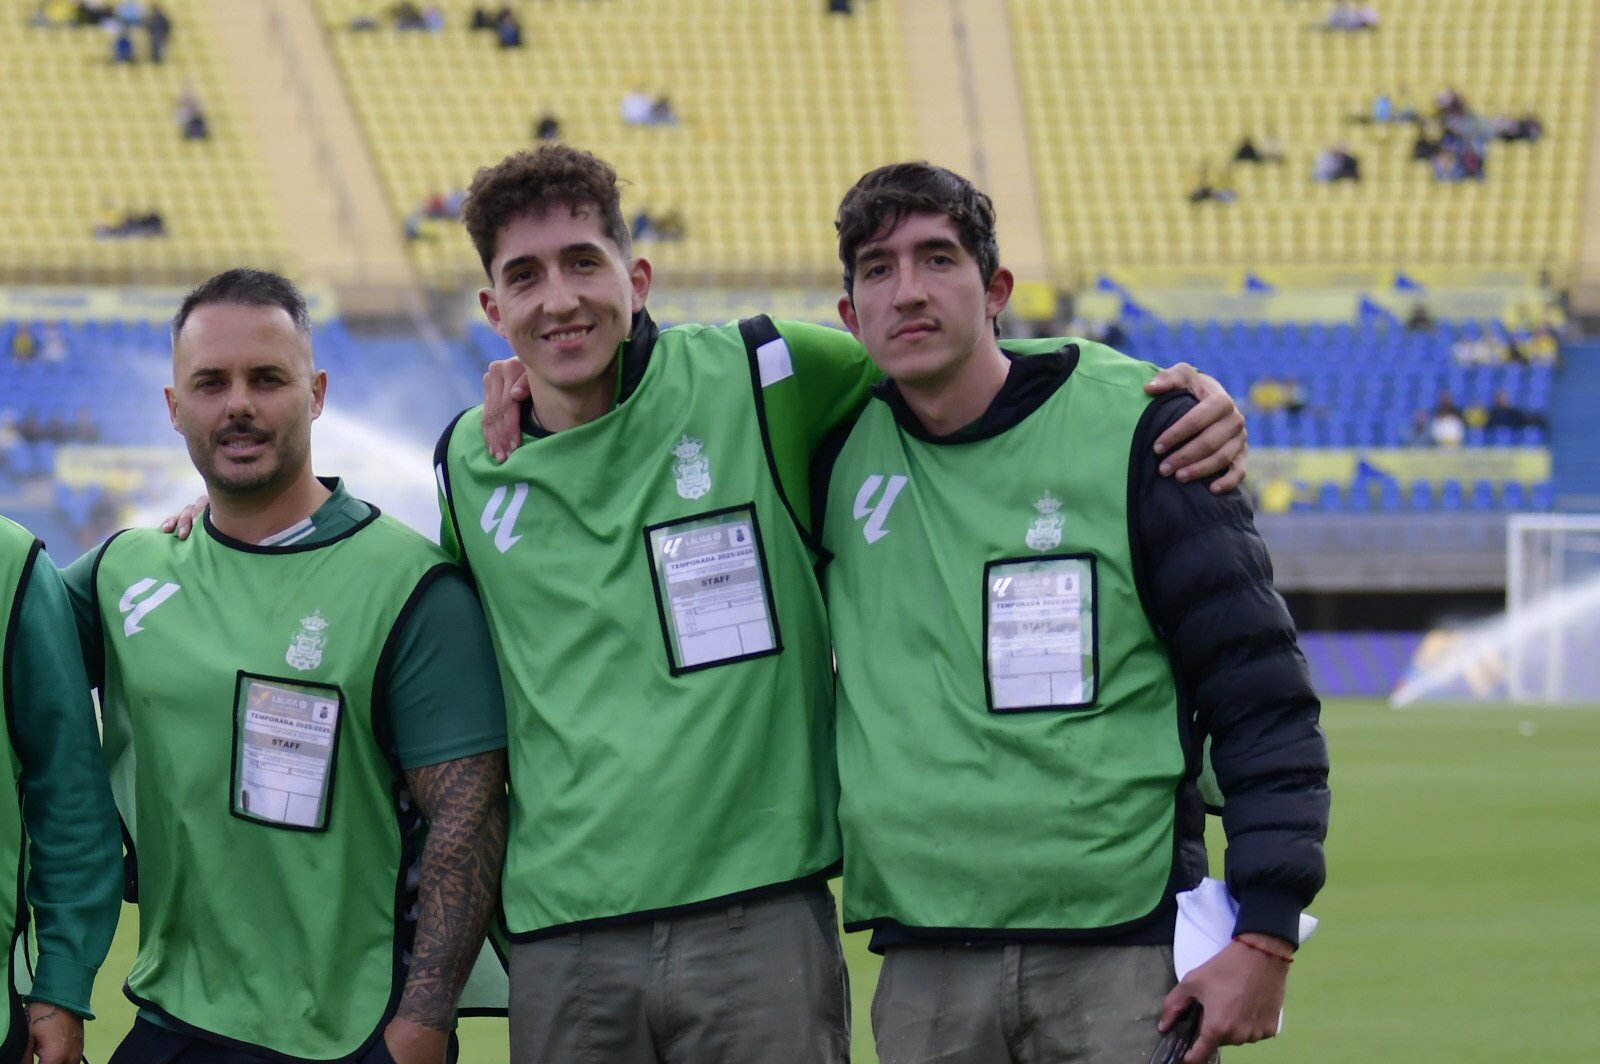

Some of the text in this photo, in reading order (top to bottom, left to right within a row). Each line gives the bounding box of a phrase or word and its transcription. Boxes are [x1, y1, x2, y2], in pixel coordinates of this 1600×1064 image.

[671, 556, 716, 570] TEMPORADA
[701, 575, 731, 587] STAFF
[250, 712, 294, 727] TEMPORADA
[271, 738, 302, 750] STAFF
